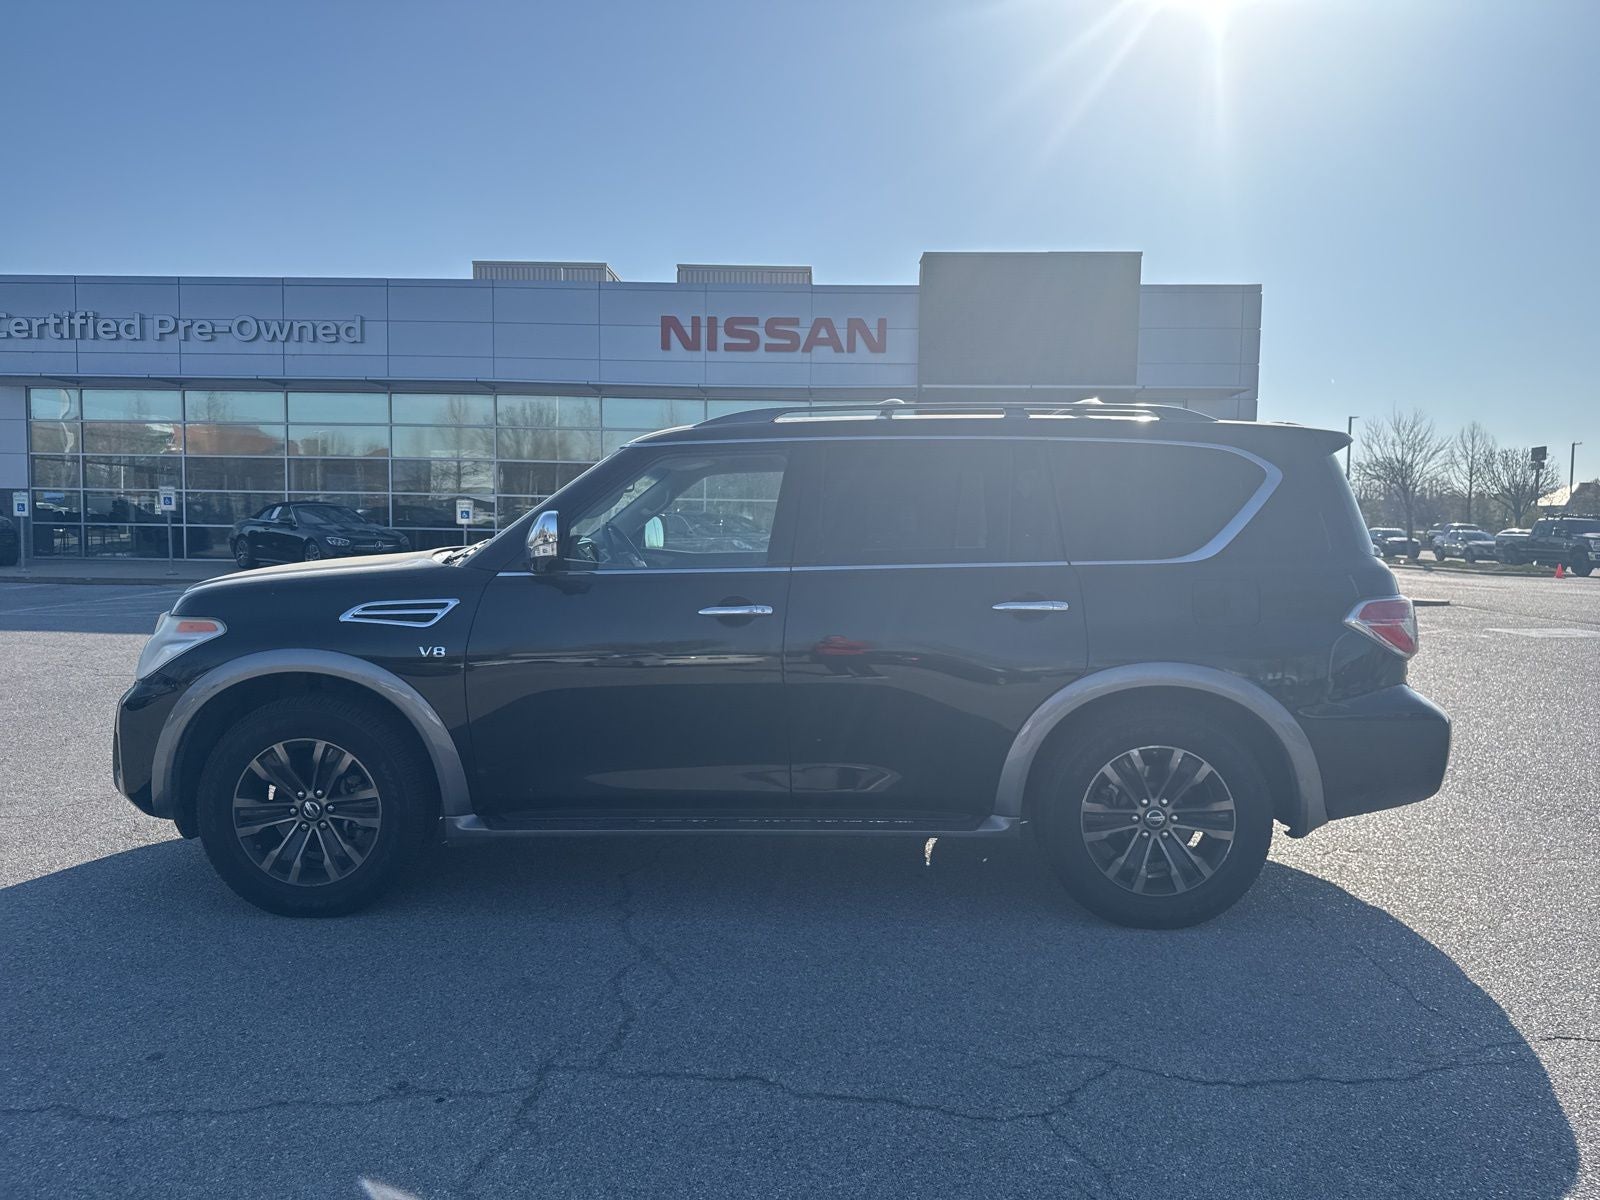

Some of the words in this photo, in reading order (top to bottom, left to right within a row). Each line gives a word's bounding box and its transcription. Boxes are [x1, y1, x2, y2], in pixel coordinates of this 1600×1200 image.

[152, 314, 363, 343] Pre-Owned
[660, 315, 887, 353] NISSAN
[418, 646, 446, 658] V8
